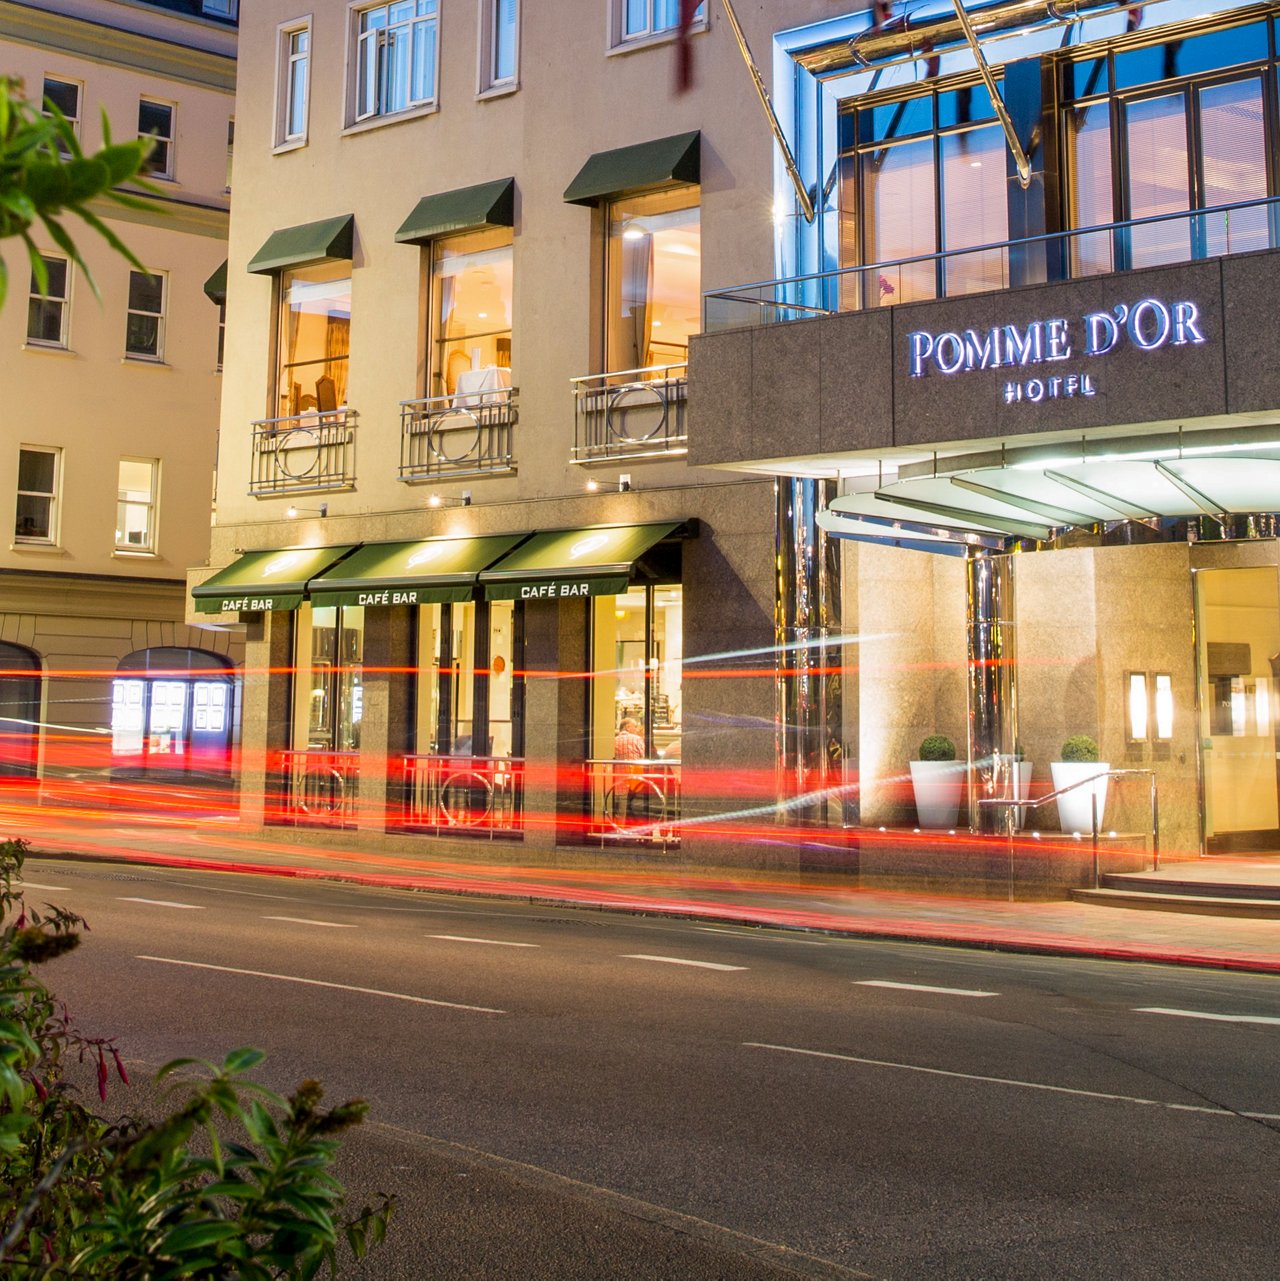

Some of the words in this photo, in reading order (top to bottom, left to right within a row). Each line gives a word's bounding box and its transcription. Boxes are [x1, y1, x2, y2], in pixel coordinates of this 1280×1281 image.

[907, 319, 1071, 378] POMME
[1082, 299, 1205, 355] D'OR
[1003, 375, 1096, 404] HOTEL
[358, 589, 389, 605] CAFÉ
[392, 591, 417, 604] BAR
[521, 581, 556, 599] CAFÉ
[560, 583, 589, 597] BAR
[221, 596, 249, 611] CAFÉ
[250, 598, 273, 610] BAR
